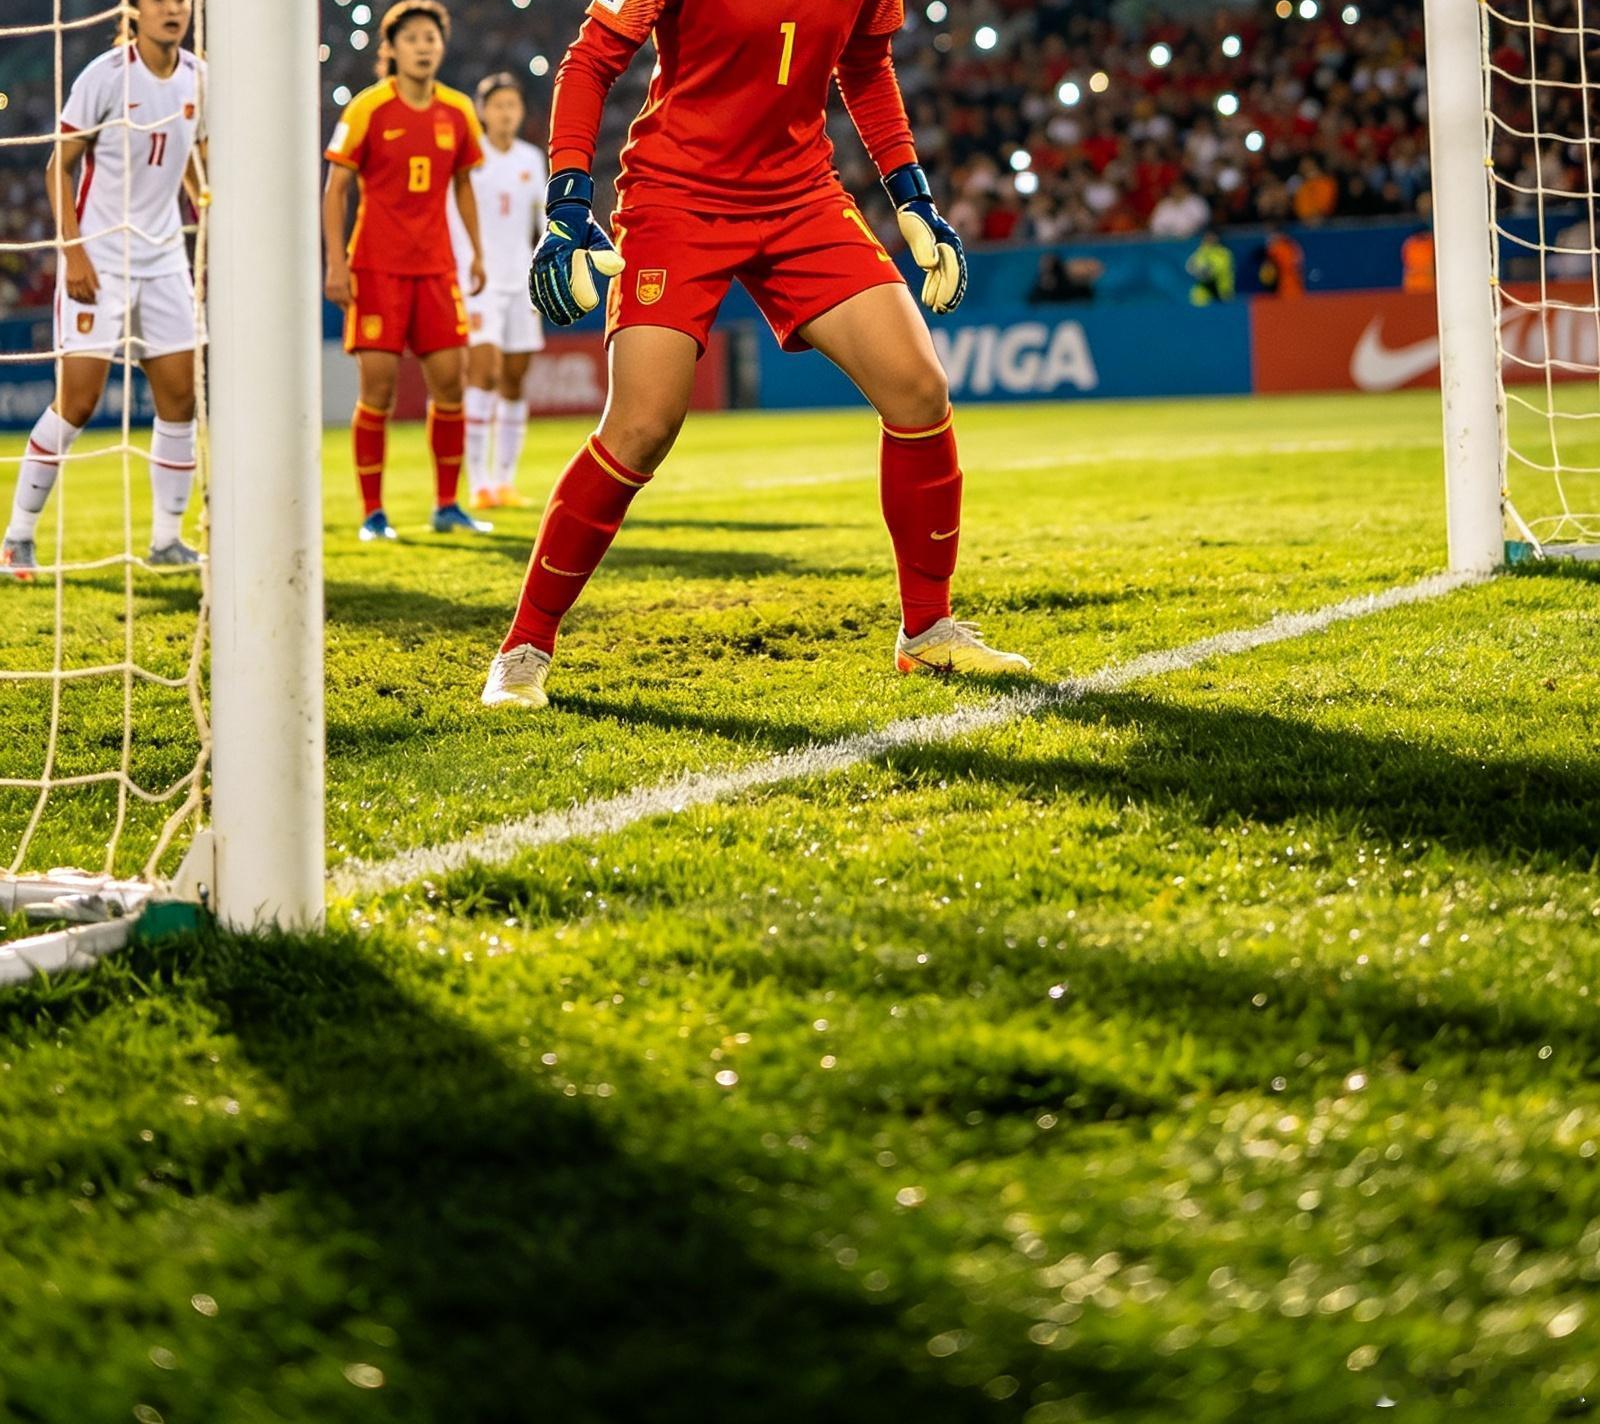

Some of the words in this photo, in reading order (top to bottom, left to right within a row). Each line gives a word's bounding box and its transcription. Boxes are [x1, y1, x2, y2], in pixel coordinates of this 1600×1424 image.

[777, 22, 796, 85] 1
[148, 132, 167, 166] 11
[408, 156, 431, 192] 8
